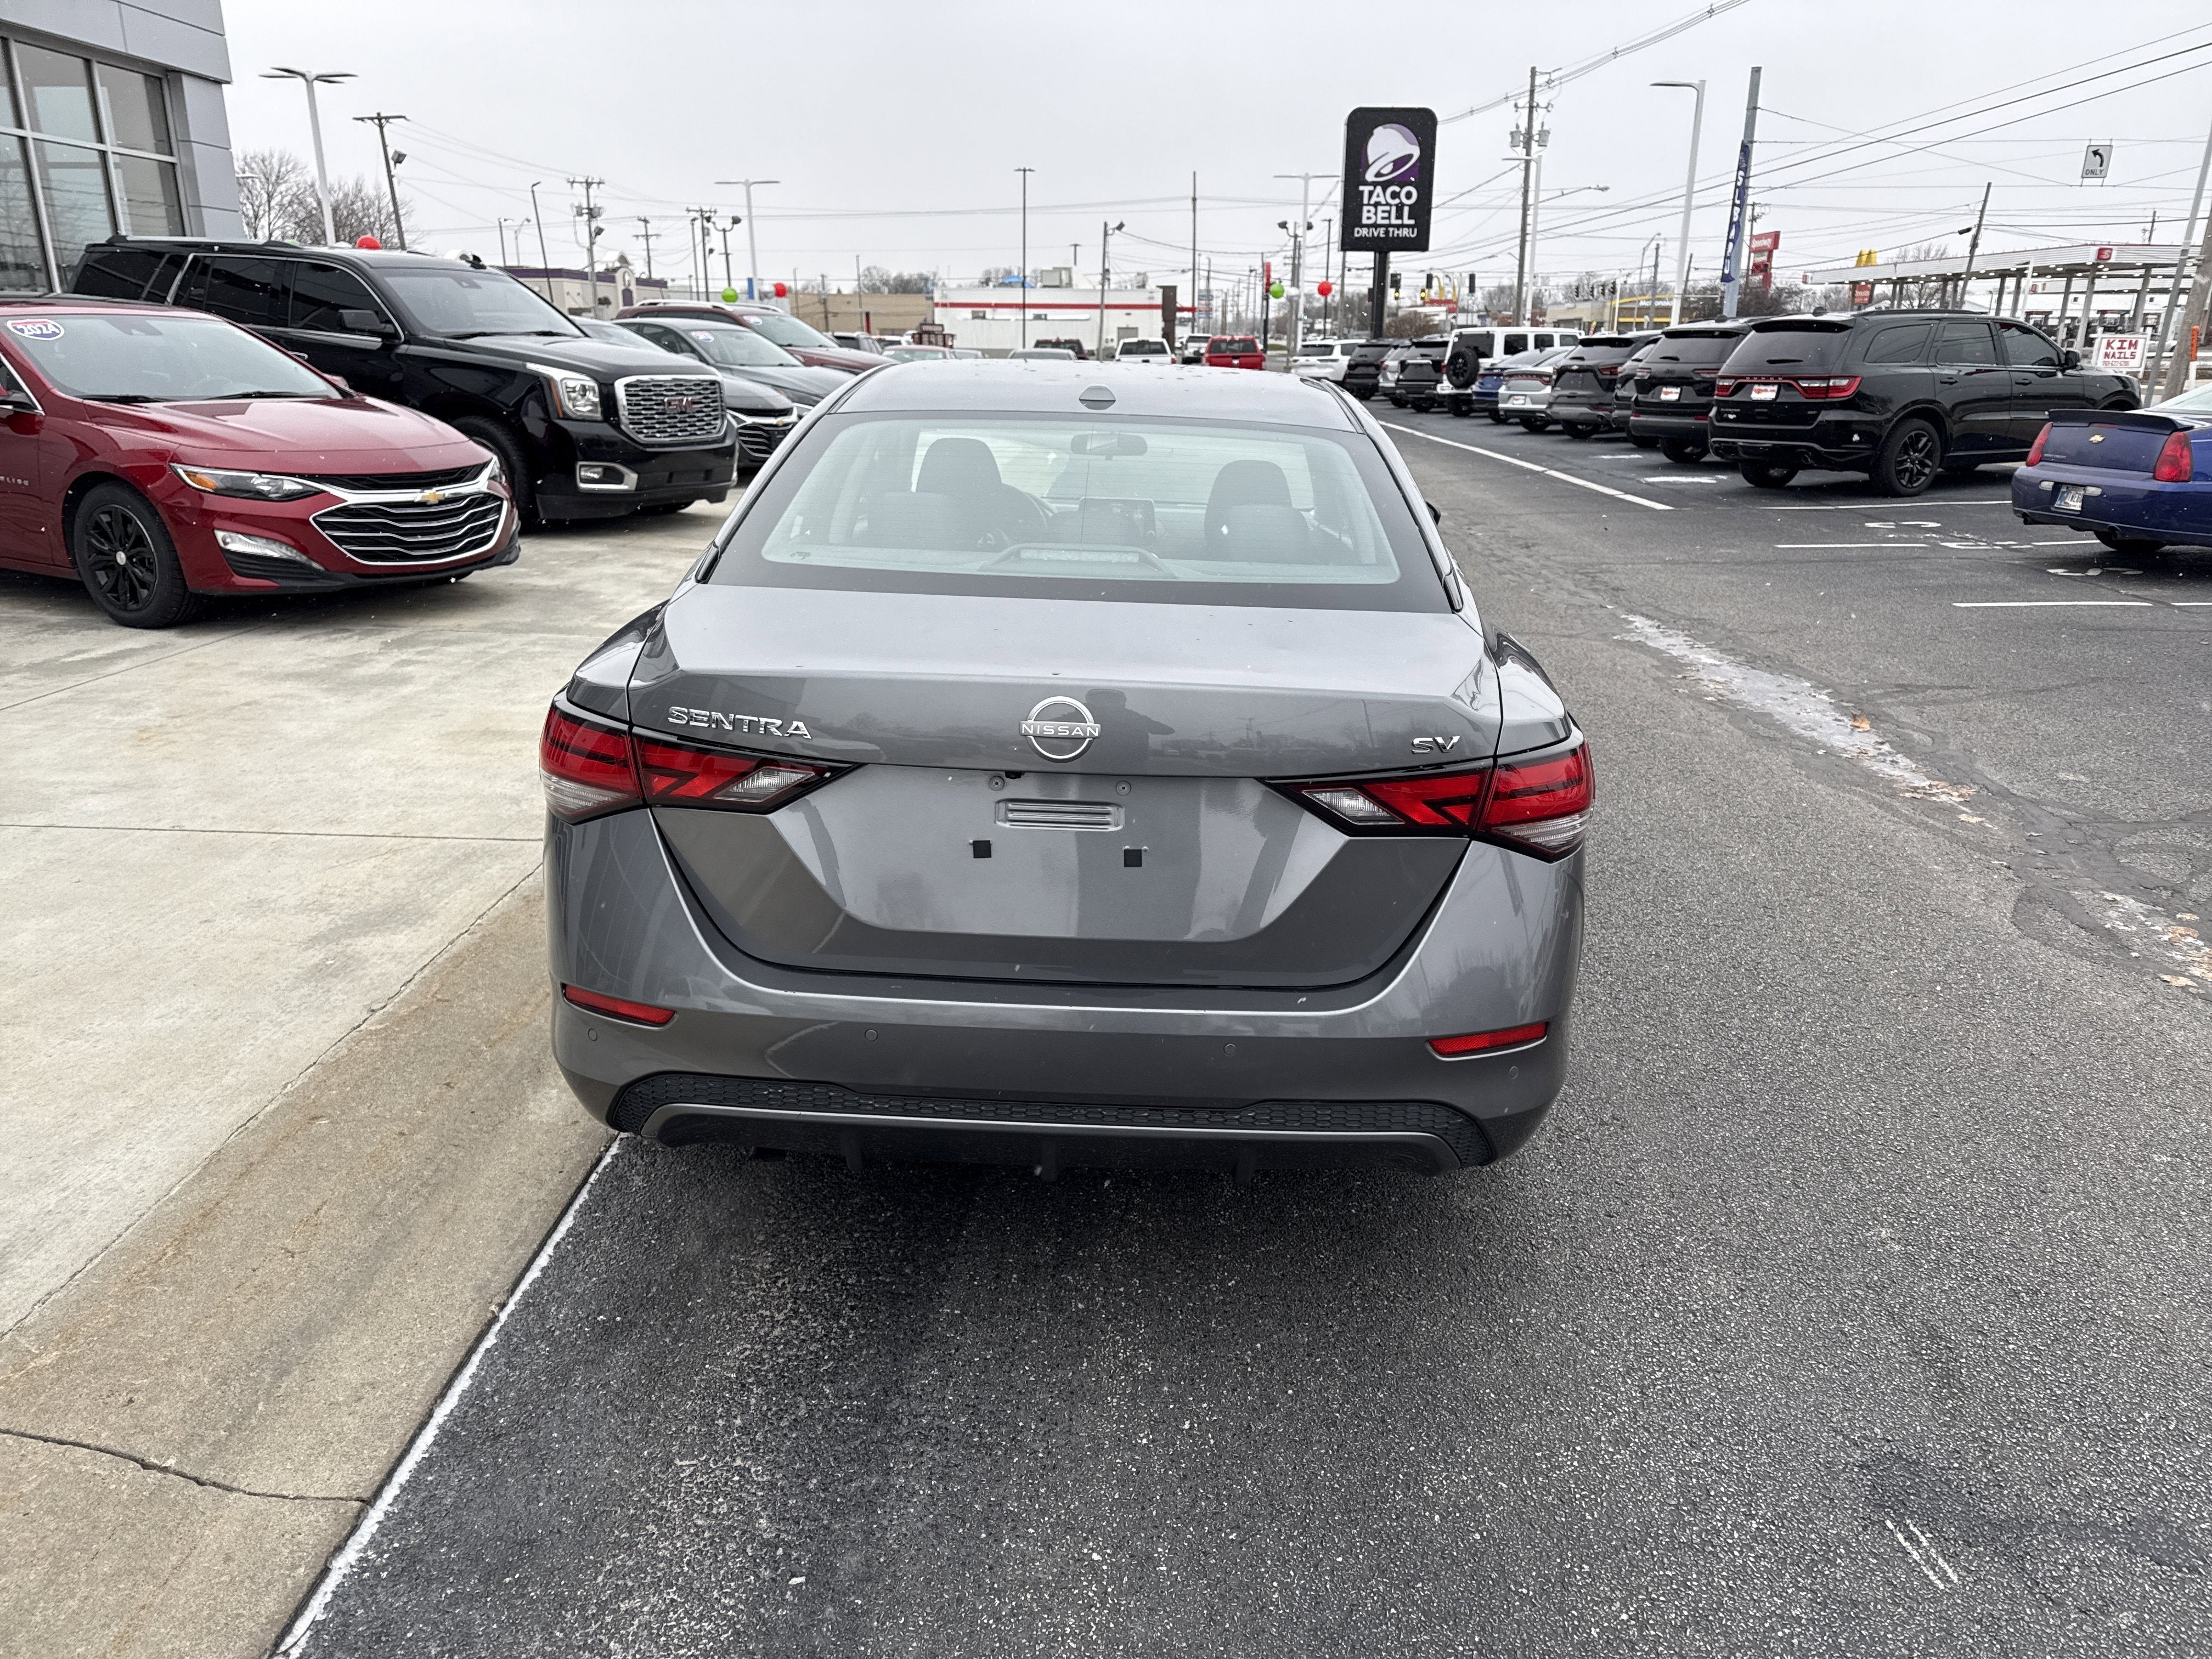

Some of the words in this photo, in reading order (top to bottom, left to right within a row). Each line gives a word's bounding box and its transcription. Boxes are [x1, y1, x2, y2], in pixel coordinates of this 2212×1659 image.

[1359, 185, 1418, 205] TACO
[1362, 205, 1415, 224] BELL
[1354, 227, 1386, 238] DRIVE
[1388, 227, 1417, 238] THRU
[16, 324, 60, 335] 2024
[2106, 340, 2138, 349] KIM
[664, 397, 699, 413] GMC
[668, 706, 812, 739] SENTRA
[1022, 724, 1098, 736] NISSAN
[1412, 736, 1460, 754] SV
